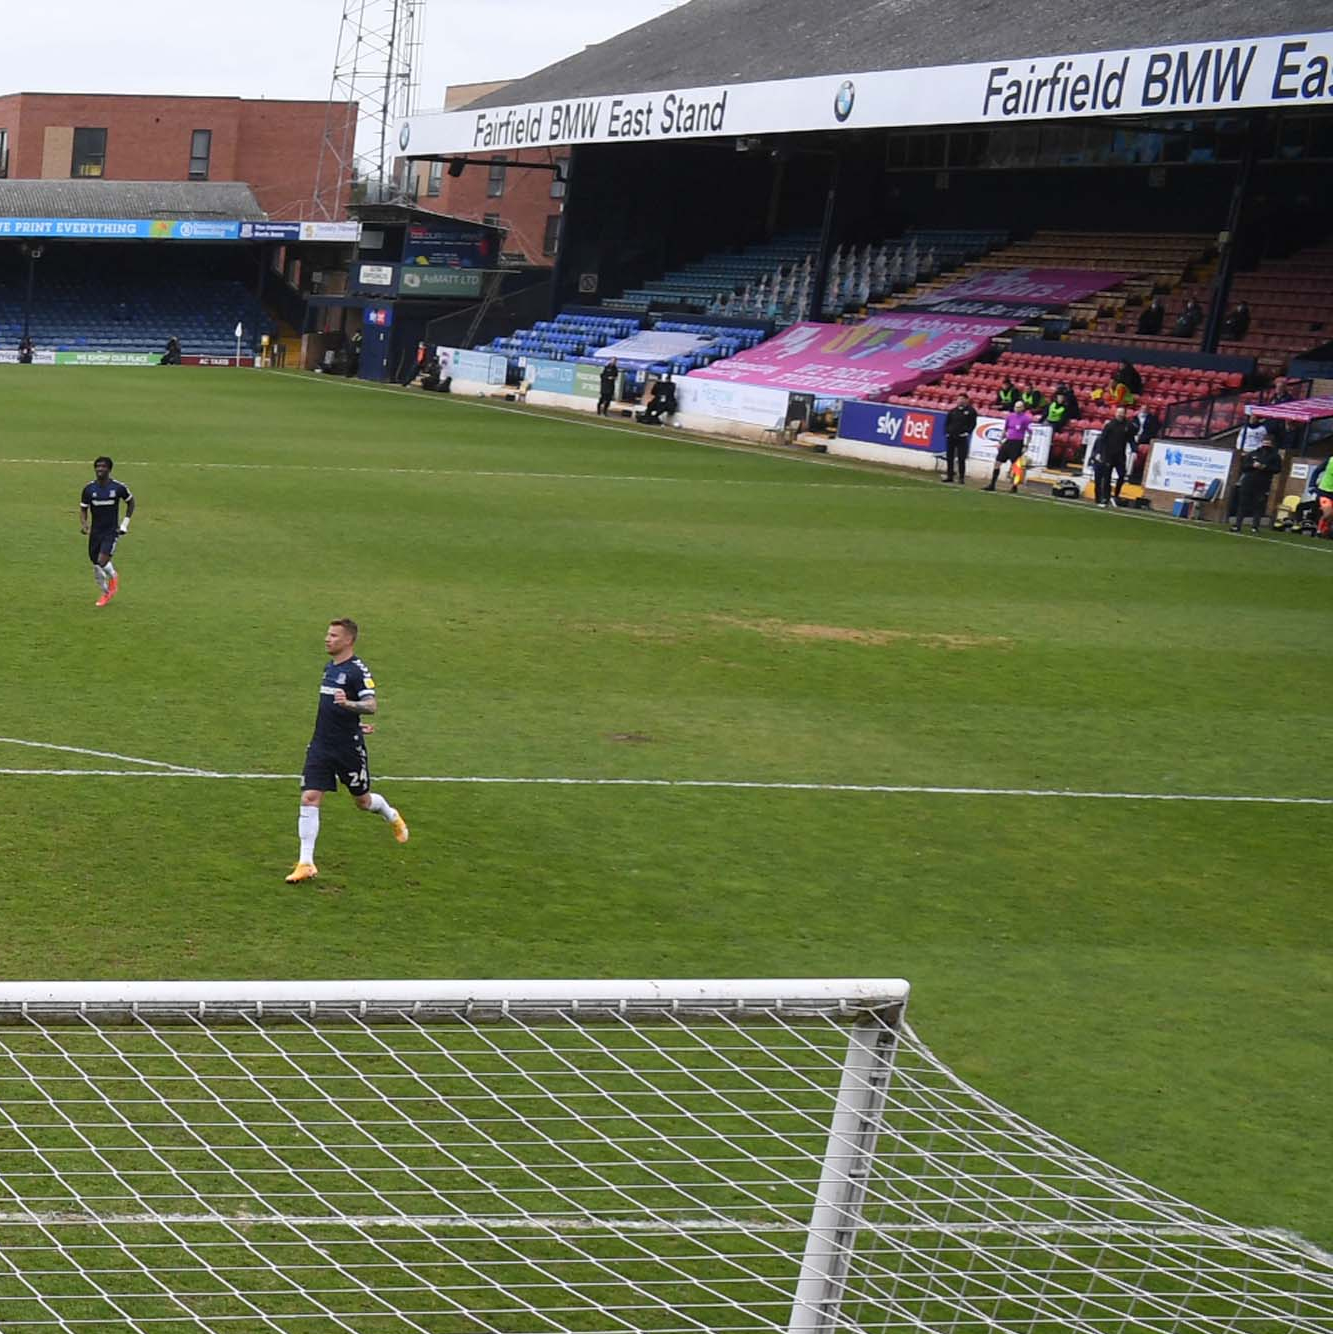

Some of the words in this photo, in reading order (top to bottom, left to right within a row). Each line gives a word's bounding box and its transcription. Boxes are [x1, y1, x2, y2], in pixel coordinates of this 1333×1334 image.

[982, 55, 1131, 116] Fairfield
[1141, 44, 1257, 107] BMW
[1271, 41, 1333, 100] Ea
[473, 107, 543, 147] Fairfield
[549, 101, 601, 141] BMW
[608, 99, 653, 137] East
[660, 90, 727, 134] Stand
[15, 222, 52, 233] PRINT
[56, 222, 137, 233] EVERYTHING
[460, 275, 479, 285] LTD
[877, 411, 903, 440] sky
[905, 414, 930, 439] bet
